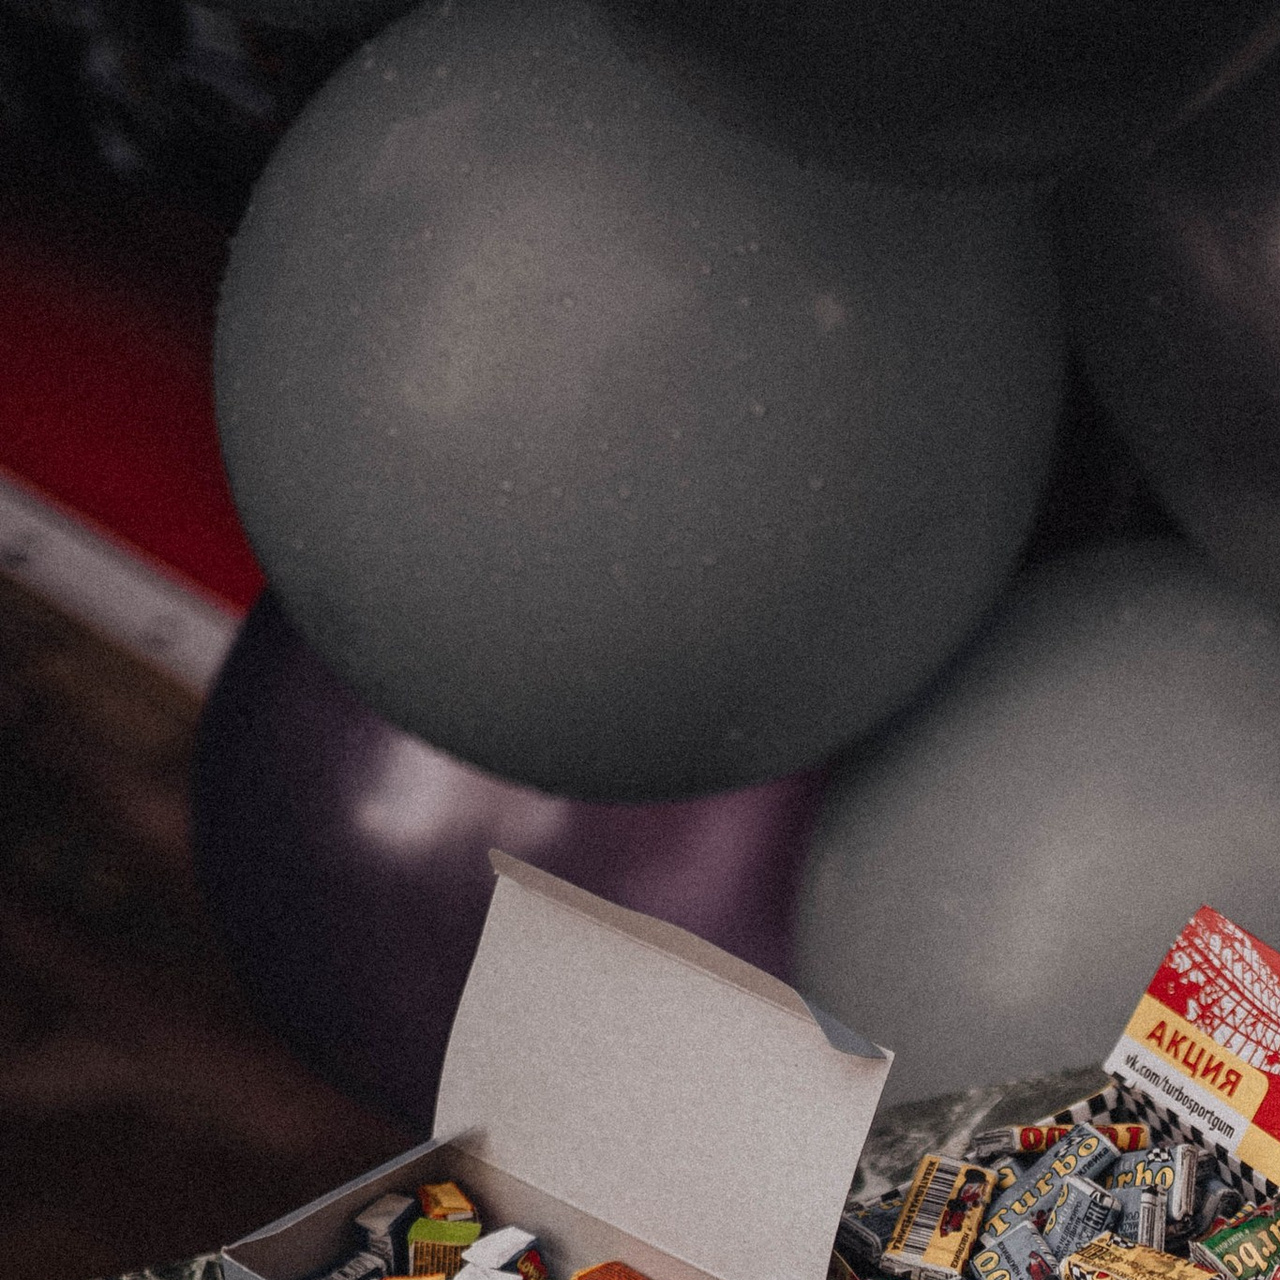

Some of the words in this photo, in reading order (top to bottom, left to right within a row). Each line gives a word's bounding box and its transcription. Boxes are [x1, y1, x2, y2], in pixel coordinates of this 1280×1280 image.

[1125, 1053, 1236, 1139] vk.com/turbosportgum
[1146, 1020, 1243, 1098] АКЦИЯ
[985, 1136, 1099, 1237] Turbo
[950, 1232, 971, 1268] наклейка
[997, 1241, 1022, 1277] наклейка
